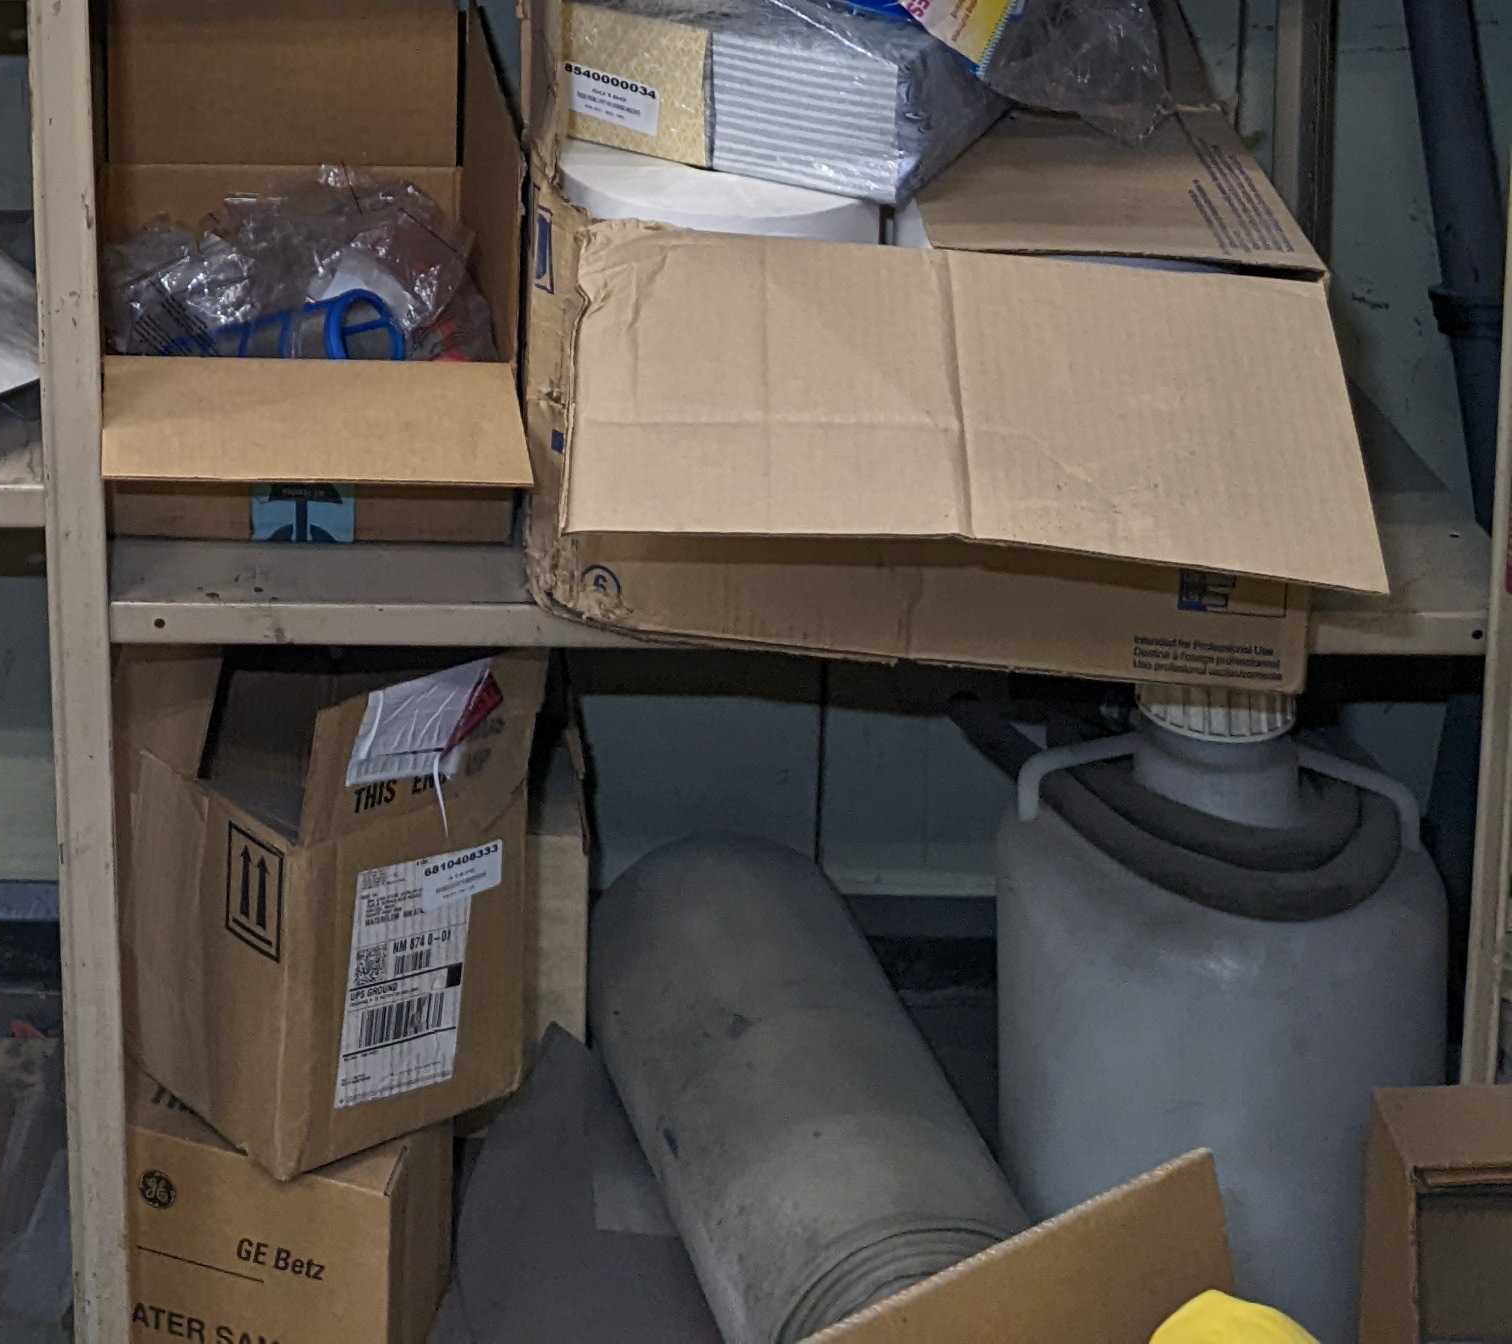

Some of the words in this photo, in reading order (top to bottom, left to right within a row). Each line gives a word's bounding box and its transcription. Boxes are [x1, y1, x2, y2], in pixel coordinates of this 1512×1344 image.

[564, 62, 656, 101] 8540000034
[1193, 640, 1252, 654] Professional
[1255, 645, 1273, 656] Use
[353, 779, 397, 813] THIS
[424, 844, 498, 877] 6810408333
[393, 941, 408, 953] NM
[350, 989, 365, 1001] UPS
[367, 982, 398, 996] GROUND
[236, 1237, 269, 1265] GE
[273, 1246, 326, 1281] Betz
